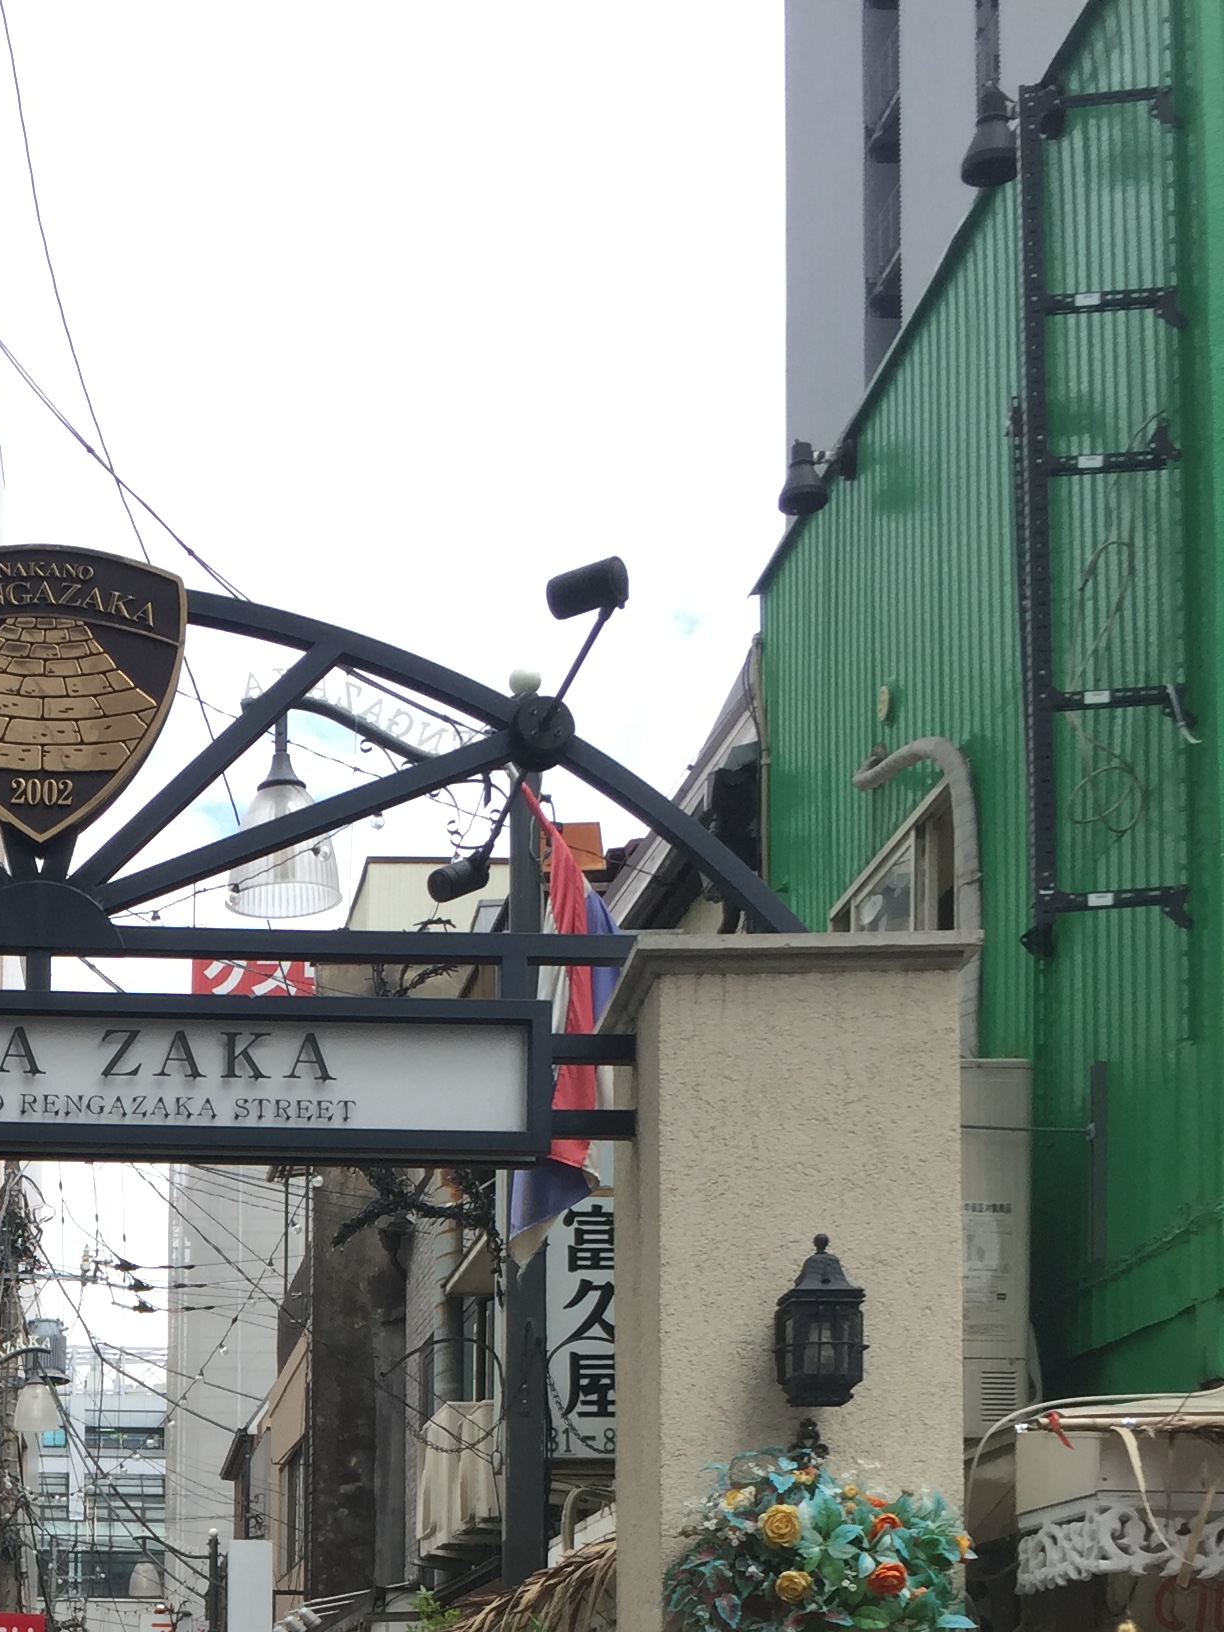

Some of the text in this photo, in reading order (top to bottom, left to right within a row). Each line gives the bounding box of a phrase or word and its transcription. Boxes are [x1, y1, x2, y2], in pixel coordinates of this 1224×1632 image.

[10, 777, 73, 806] 2002
[100, 1028, 337, 1082] ZAKA
[19, 1093, 219, 1119] RENGAZAKA
[233, 1098, 358, 1122] STREET
